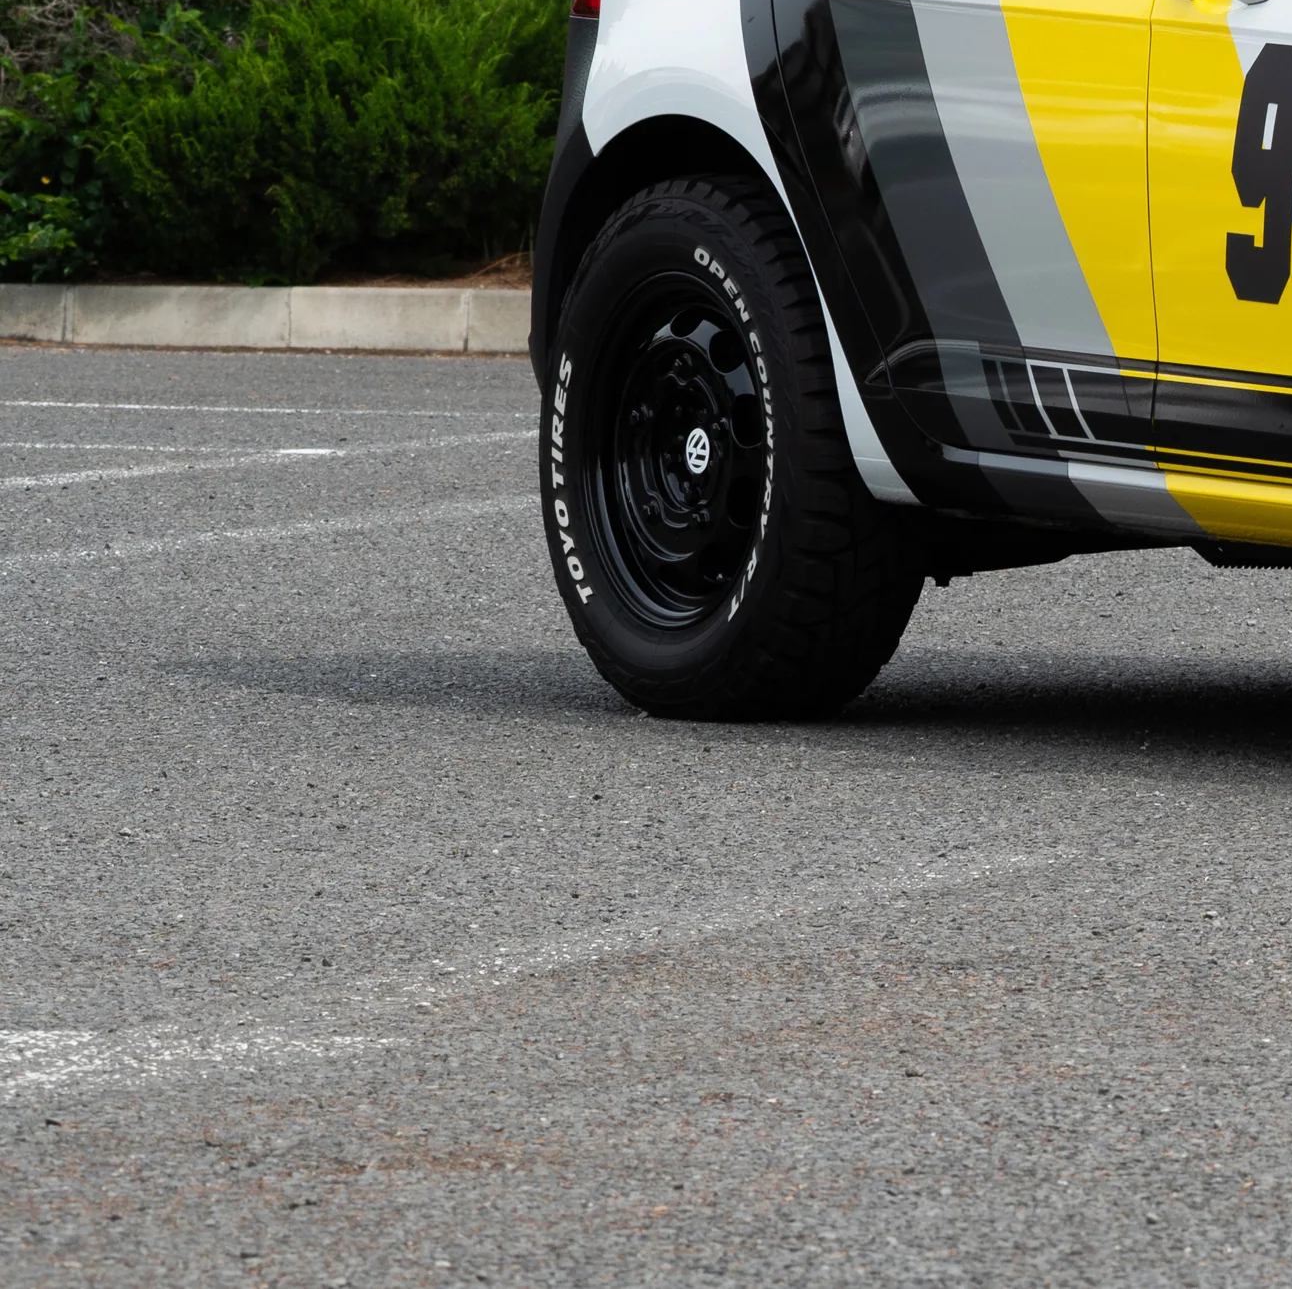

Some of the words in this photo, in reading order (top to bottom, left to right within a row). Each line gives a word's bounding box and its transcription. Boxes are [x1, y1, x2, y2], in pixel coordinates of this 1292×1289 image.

[550, 350, 573, 490] TIRES
[693, 247, 751, 324] OPEN
[747, 330, 775, 543] COUNTRY
[553, 498, 594, 606] TOYO
